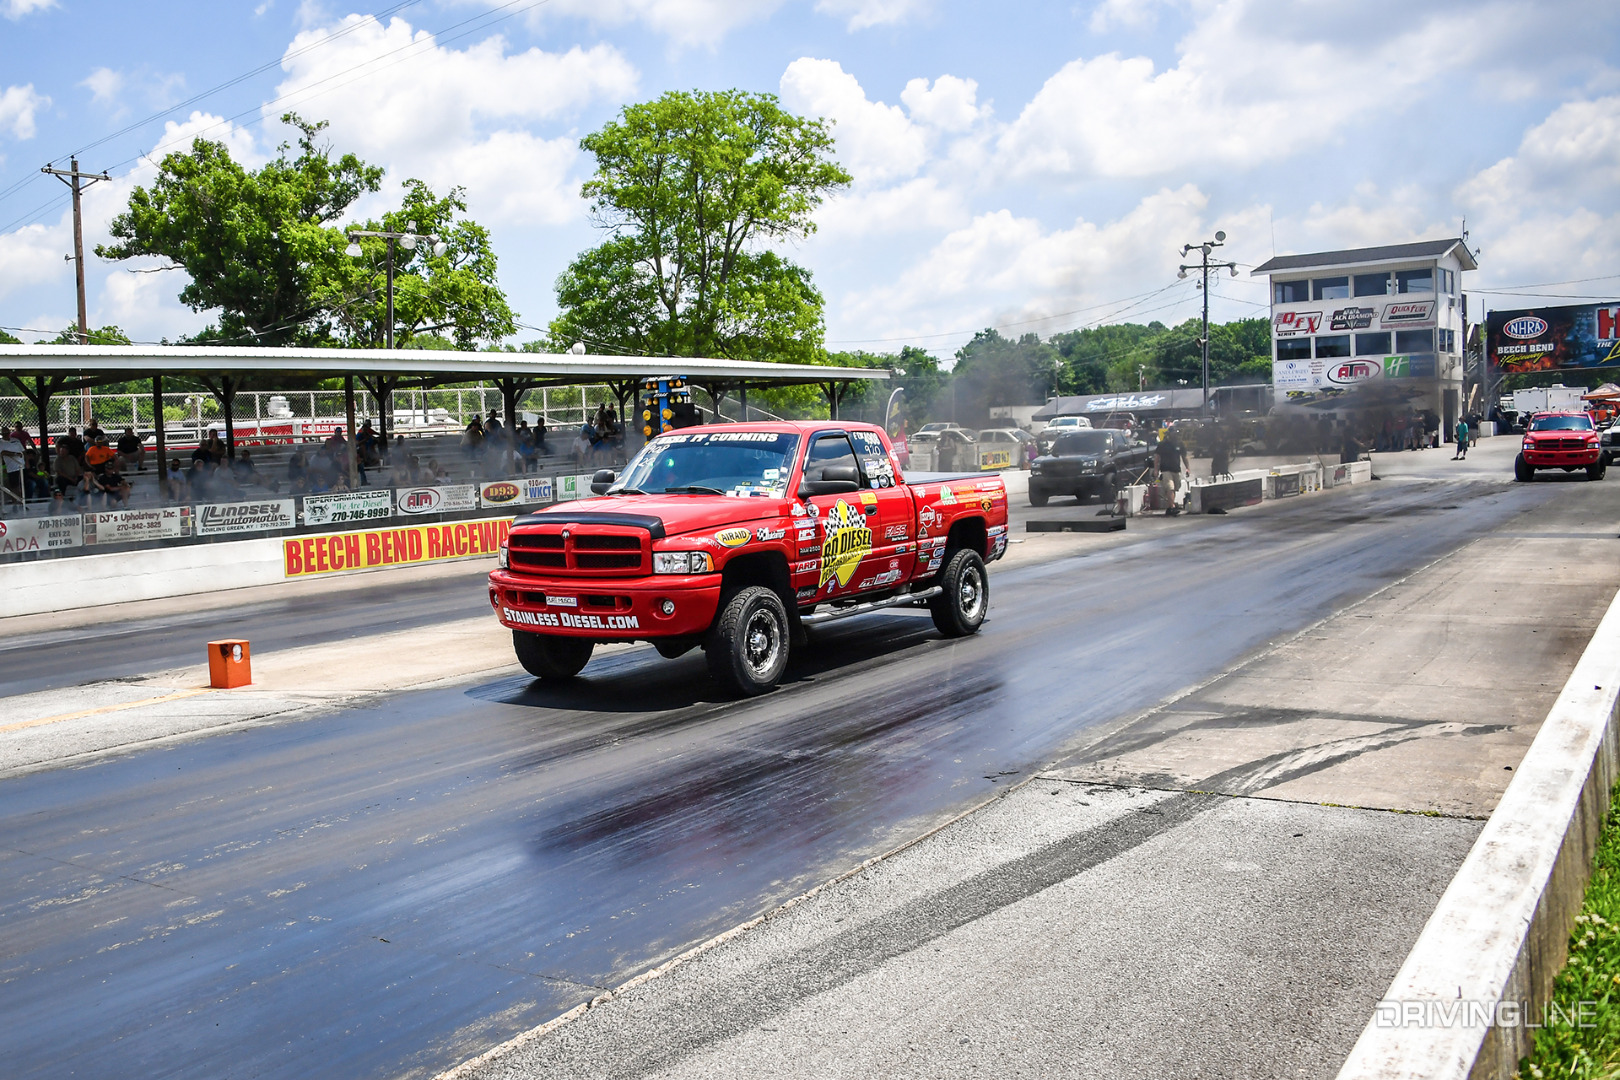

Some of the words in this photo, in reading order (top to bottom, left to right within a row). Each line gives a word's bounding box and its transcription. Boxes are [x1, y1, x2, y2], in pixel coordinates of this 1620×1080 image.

[1325, 314, 1347, 322] BLACK
[1347, 312, 1379, 320] DIAMOND
[1510, 320, 1541, 335] NHRA
[1497, 345, 1527, 354] BEECH
[1529, 343, 1555, 352] BEND
[1337, 362, 1370, 378] ATM
[709, 433, 780, 442] CUMMINS
[489, 486, 515, 497] D93
[529, 485, 552, 498] WKCT
[407, 491, 433, 507] ATM
[99, 513, 118, 523] DJ's
[120, 511, 161, 523] Upholstery
[162, 510, 178, 518] Inc.
[209, 503, 281, 518] LINDSEY
[331, 507, 390, 522] 270-746-9999
[222, 512, 287, 526] automotive
[721, 530, 748, 542] AIRAID
[884, 524, 907, 538] FASS
[48, 539, 59, 547] OFF
[840, 529, 872, 555] DIESEL
[285, 534, 360, 575] BEECH
[365, 528, 423, 566] BEND
[797, 560, 816, 571] ARP
[502, 607, 559, 627] STAINLESS
[560, 612, 640, 629] DIESEL.COM
